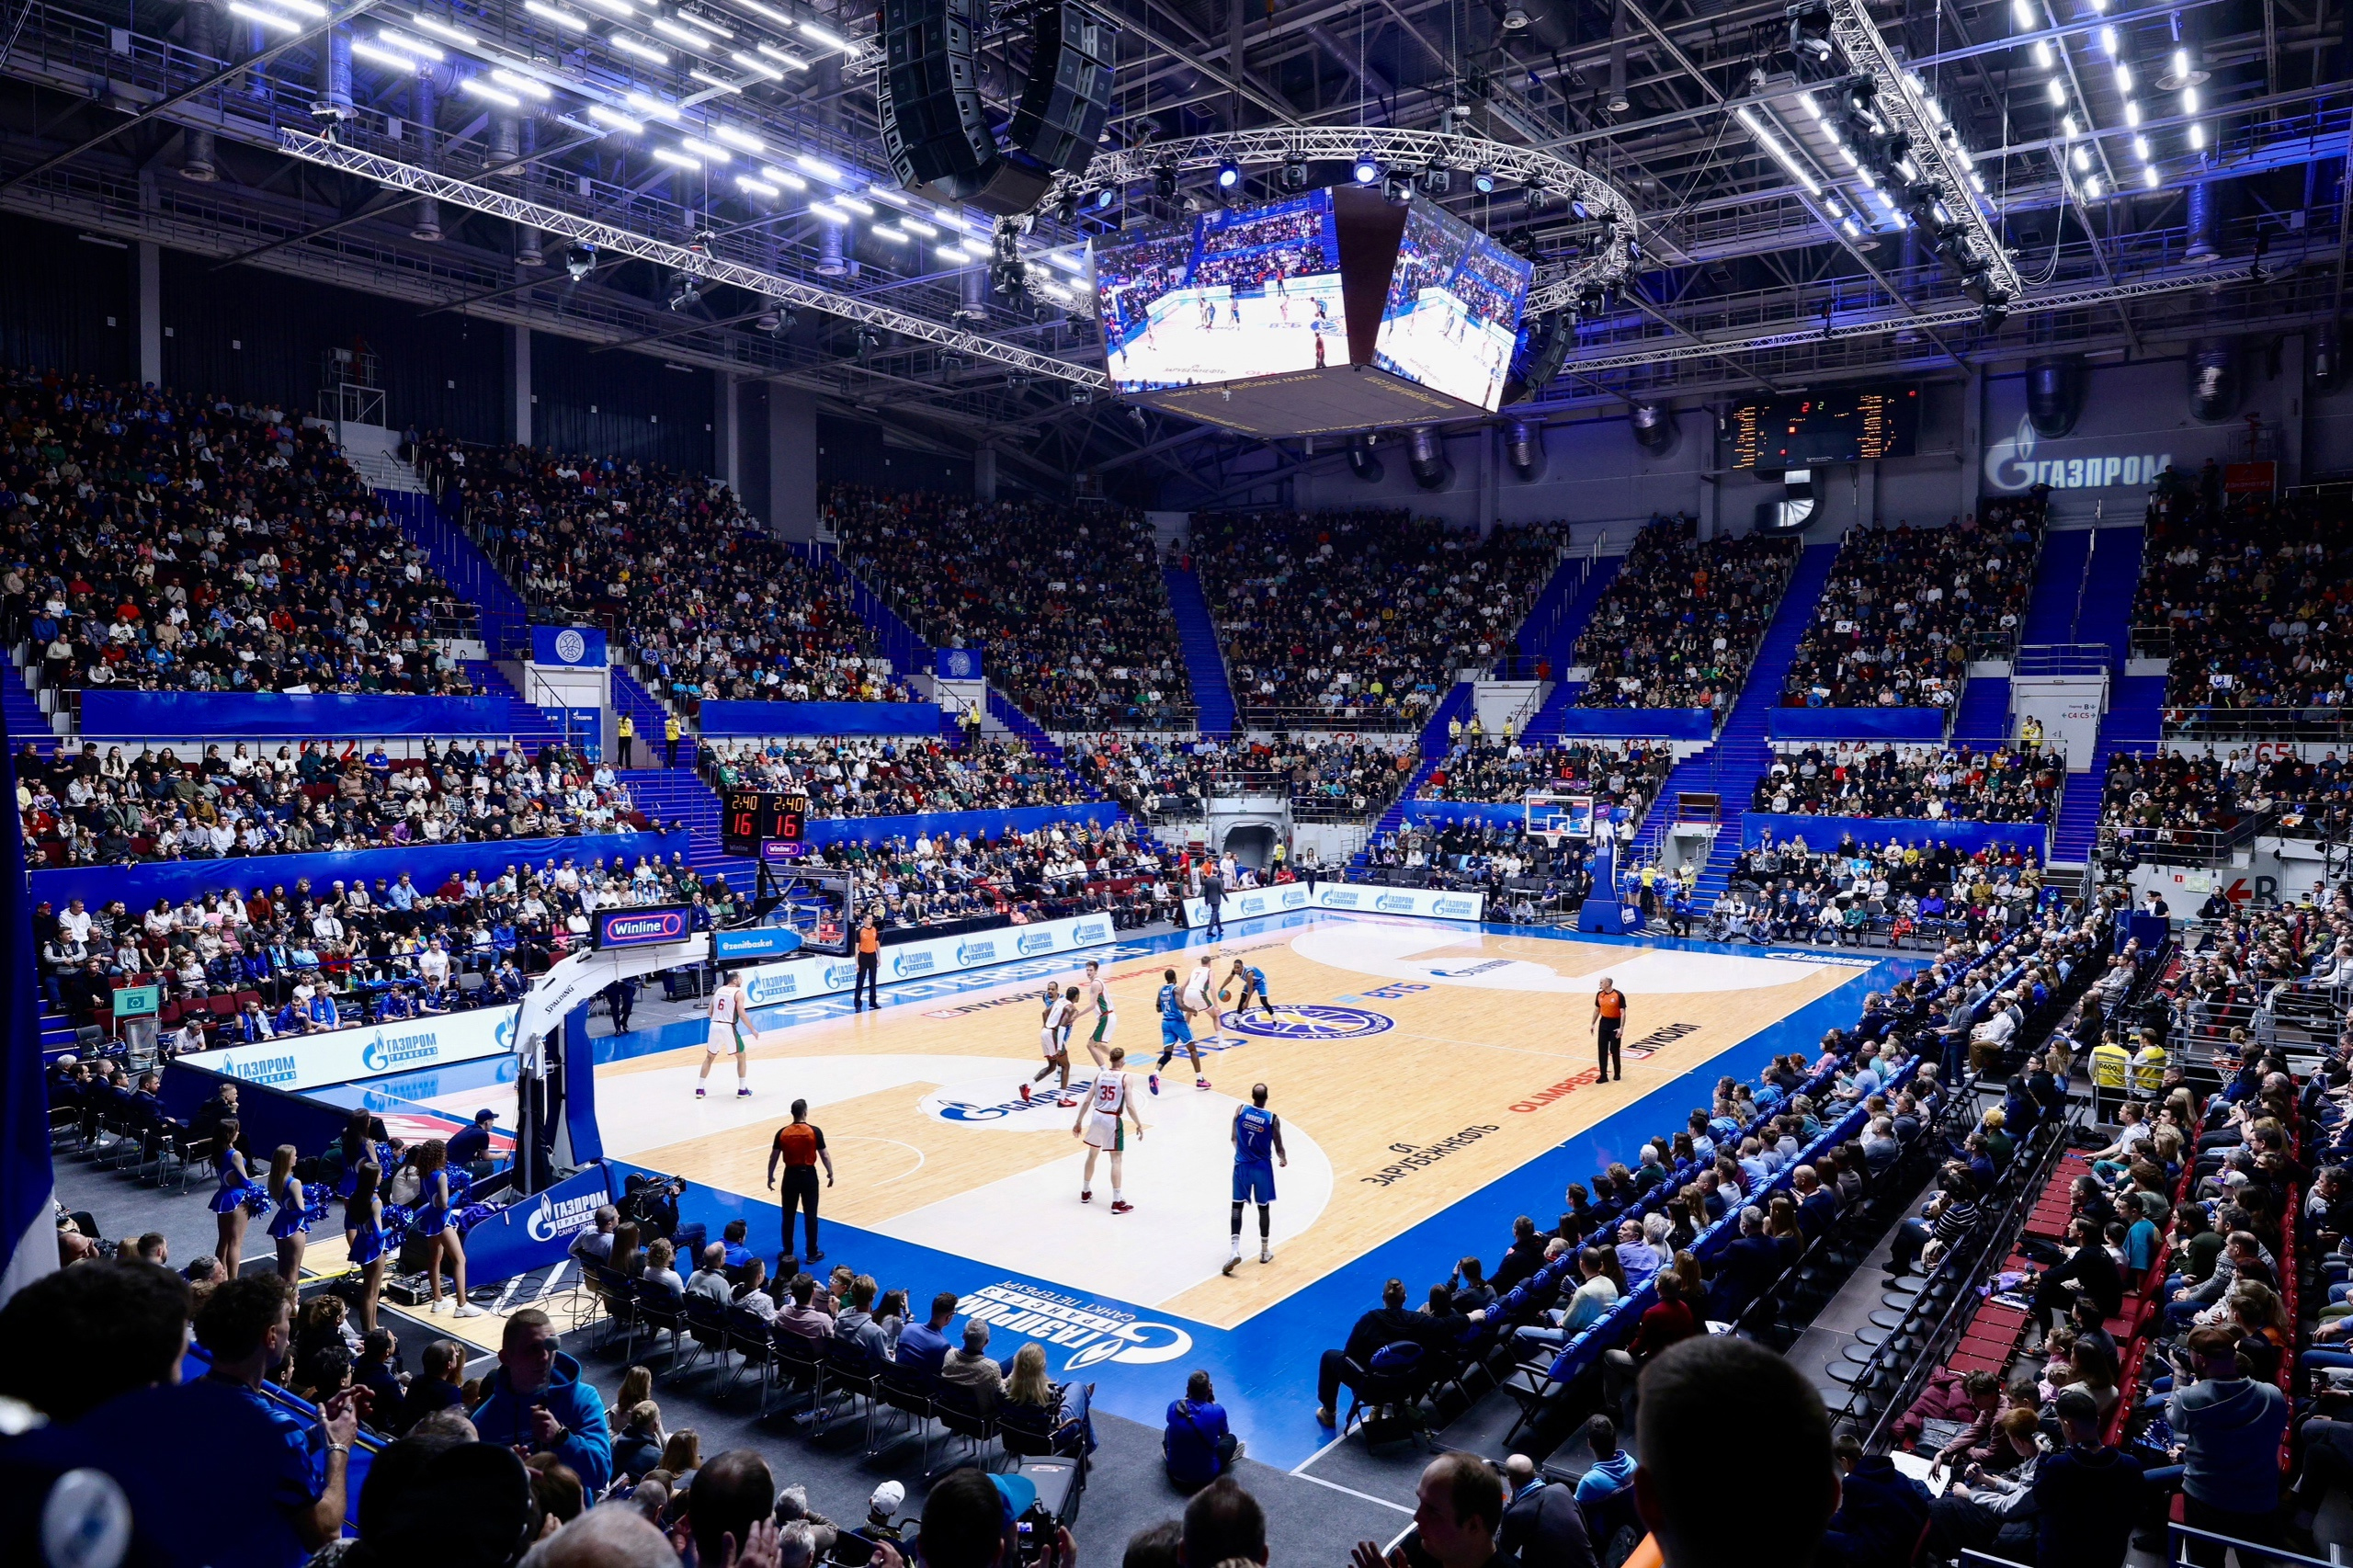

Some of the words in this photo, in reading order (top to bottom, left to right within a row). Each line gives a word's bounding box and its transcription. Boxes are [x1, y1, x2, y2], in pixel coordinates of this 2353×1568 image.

[2038, 455, 2172, 489] ГАЗПРОМ
[1560, 767, 1574, 778] 16
[732, 794, 757, 811] 2:40
[773, 796, 804, 812] 2:40
[733, 813, 752, 835] 16
[776, 814, 797, 836] 16
[769, 845, 790, 853] Winline
[2255, 875, 2278, 910] B
[614, 922, 661, 936] Winline
[1027, 931, 1051, 944] ГАЗПРОМ
[1082, 923, 1104, 935] ГАЗПРОМ
[722, 938, 773, 950] @zenitbasket
[968, 939, 994, 953] ГАЗПРОМ
[905, 951, 933, 964] ГАЗПРОМ
[838, 963, 857, 976] ГАЗПР
[849, 946, 1153, 1004] PETERSBURG
[762, 974, 795, 988] ГАЗПРОМ
[545, 984, 574, 1015] SPALDING
[1361, 983, 1431, 1000] ВТБ
[718, 998, 725, 1010] 6
[386, 1033, 437, 1052] ГАЗПРОМ
[1627, 1023, 1702, 1052] ЛУКОЙЛ
[390, 1047, 438, 1062] ТРАНСГАЗ
[237, 1056, 295, 1078] ГАЗПРОМ
[248, 1072, 296, 1085] АНСГАЗ
[1099, 1085, 1116, 1101] 35
[1508, 1066, 1612, 1113] OLIMPBET
[1247, 1131, 1256, 1147] 7
[1360, 1124, 1500, 1187] ЗАРУБЕЖНЕФТЬ
[553, 1190, 609, 1219] ГАЗПРОМ
[558, 1210, 597, 1228] ТРАНСГ
[995, 1279, 1079, 1309] ПЕТЕРБУРГ
[983, 1288, 1107, 1332] ТРАНСГАЗ
[1080, 1303, 1136, 1322] САНКТ
[956, 1294, 1104, 1349] ГАЗПРОМ
